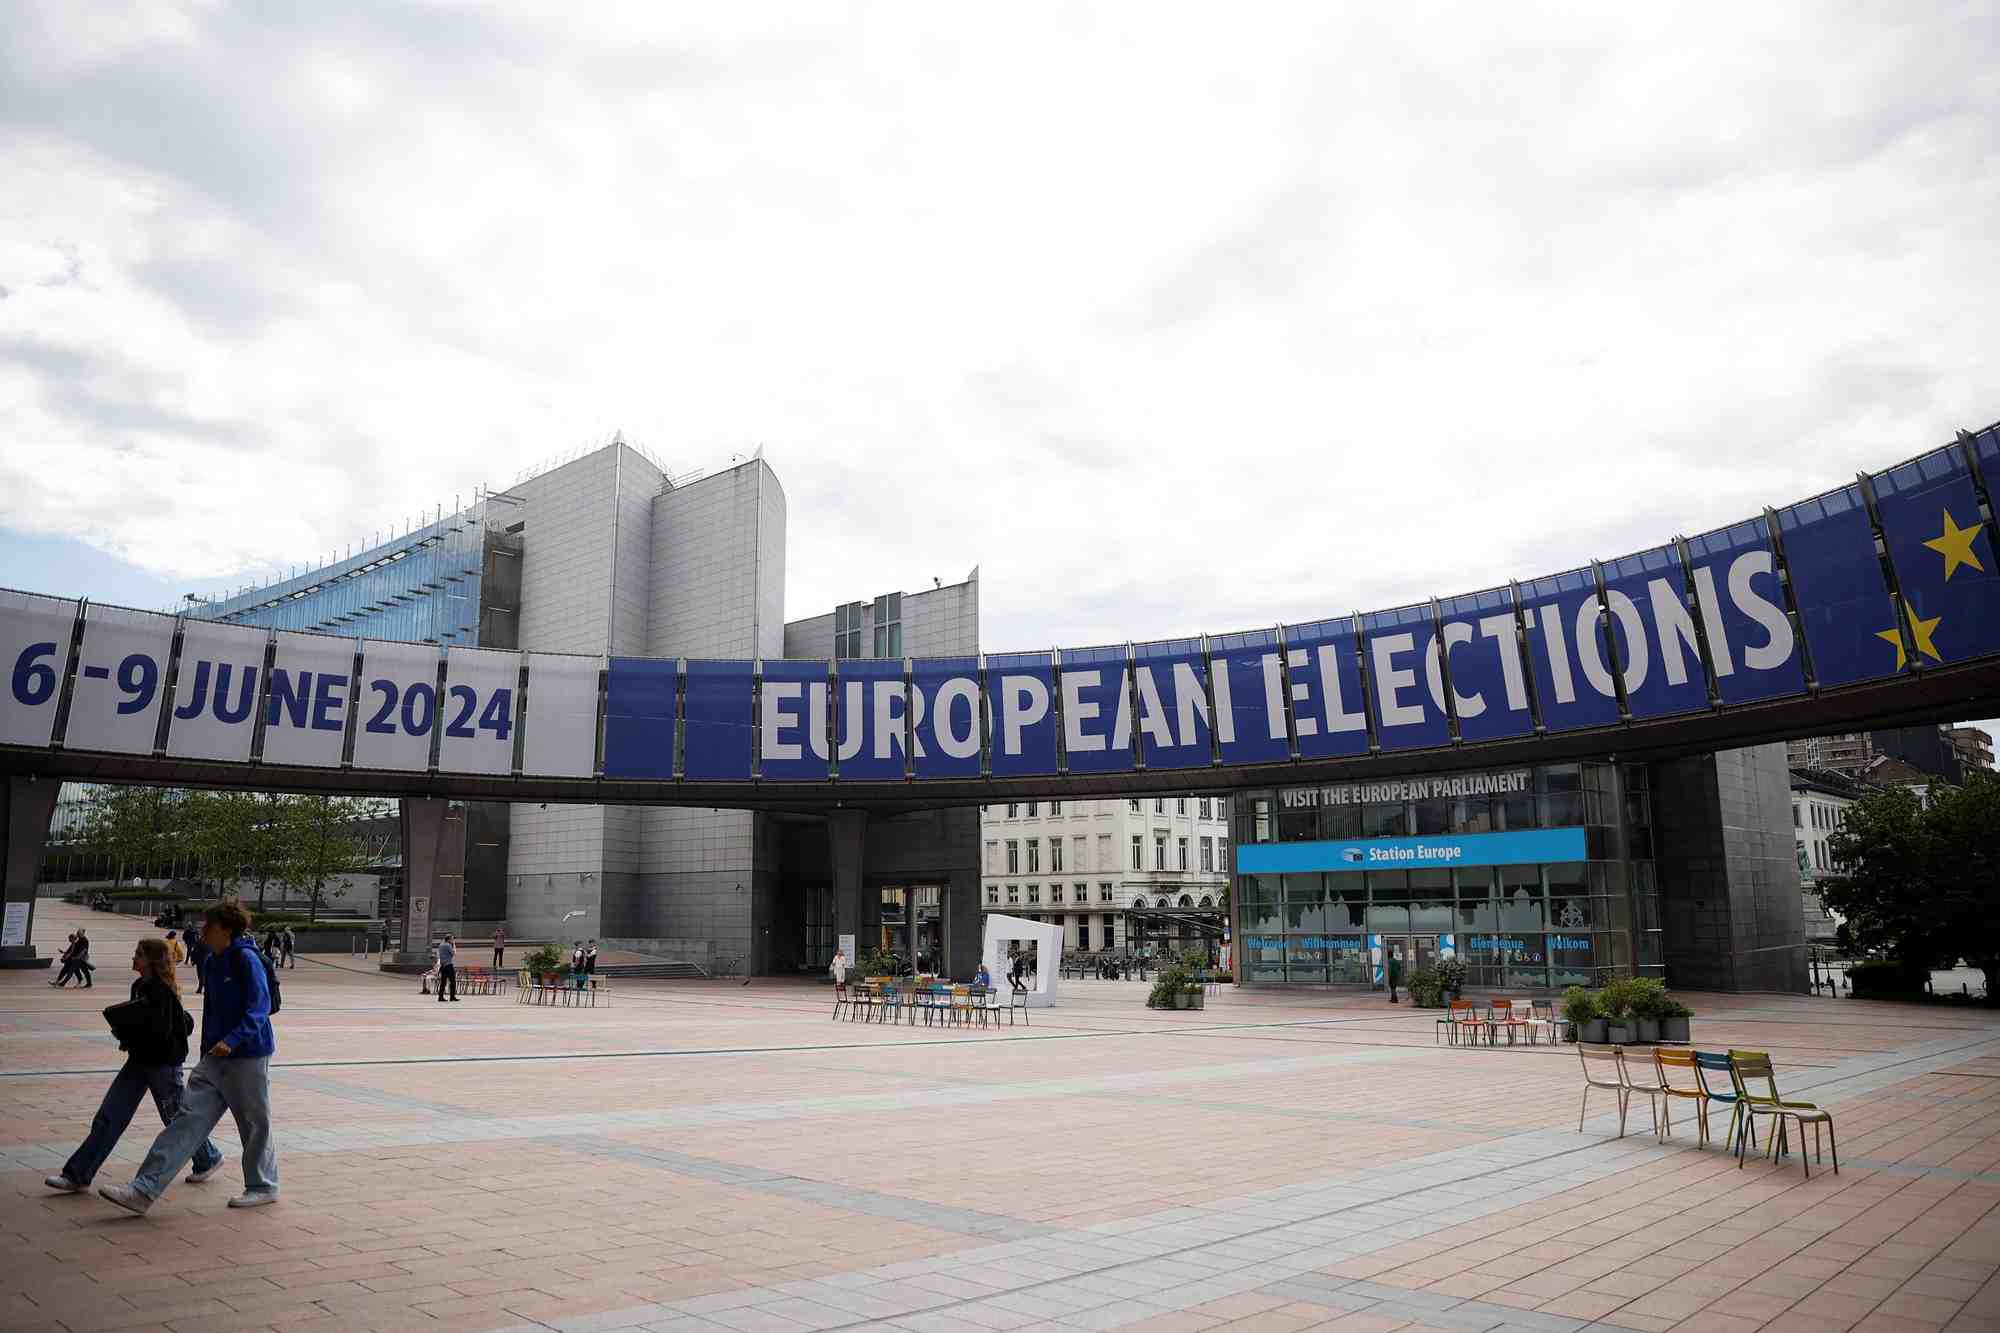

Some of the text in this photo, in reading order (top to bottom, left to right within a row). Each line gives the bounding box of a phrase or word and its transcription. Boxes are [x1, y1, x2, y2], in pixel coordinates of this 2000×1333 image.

[761, 550, 1796, 760] EUROPEAN ELECTIONS
[174, 660, 349, 732] JUNE
[366, 678, 514, 741] 2024
[1283, 772, 1528, 808] VISIT THE EUROPEAN PARLIAMENT
[1369, 844, 1462, 861] Station Europe
